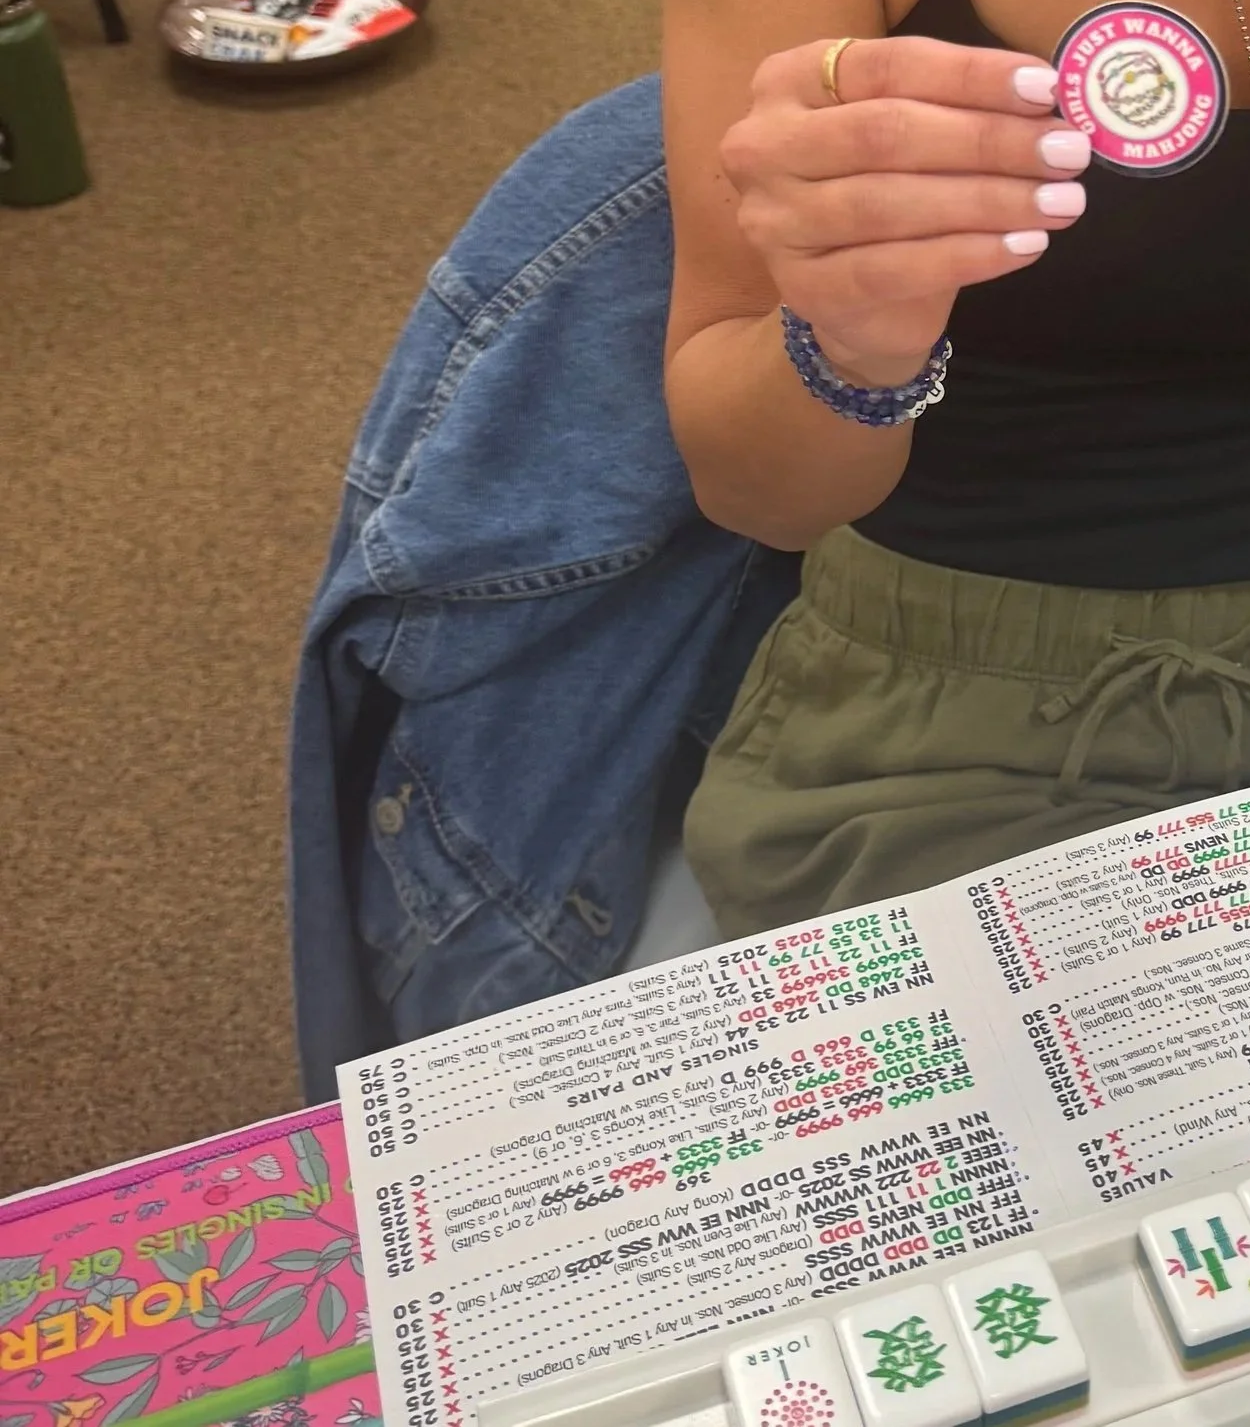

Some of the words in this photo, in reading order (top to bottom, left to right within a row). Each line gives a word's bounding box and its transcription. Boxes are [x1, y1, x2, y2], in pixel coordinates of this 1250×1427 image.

[1072, 23, 1116, 67] JUST
[1122, 18, 1205, 72] WANNA
[1066, 72, 1096, 136] GIRLS
[1122, 94, 1212, 158] MAHJONG
[831, 913, 880, 935] 2025
[887, 906, 908, 921] FF
[774, 928, 825, 951] 2025
[717, 944, 768, 967] 2025
[668, 970, 678, 981] 3
[680, 959, 709, 976] (Any
[628, 974, 666, 992] Suits)
[390, 1057, 405, 1069] C
[681, 1038, 759, 1071] SINGLES
[358, 1064, 383, 1081] 75
[631, 1064, 672, 1086] AND
[567, 1081, 624, 1108] PAIRS
[939, 1075, 975, 1094] 333
[887, 1086, 934, 1109] 6666
[847, 1101, 883, 1121] 666
[957, 1110, 990, 1130] NN
[1214, 1105, 1237, 1121] Any
[795, 1113, 844, 1138] 9999
[926, 1122, 951, 1139] EE
[1173, 1115, 1213, 1136] Wind)
[726, 1138, 764, 1160] 333
[860, 1132, 921, 1160] WWW
[1112, 1145, 1130, 1160] X
[671, 1152, 721, 1177] 6666
[812, 1152, 851, 1174] SSS
[1084, 1154, 1110, 1172] 45
[1119, 1161, 1137, 1176] X
[628, 1170, 666, 1192] 666
[675, 1171, 711, 1192] 369
[740, 1167, 805, 1197] DDDD
[1091, 1170, 1117, 1187] 40
[1100, 1168, 1173, 1202] VALUES
[297, 1182, 332, 1210] IN
[573, 1184, 624, 1210] 9999
[693, 1187, 734, 1209] (Kong
[990, 1189, 1022, 1210] FFF
[537, 1199, 567, 1220] (Any
[664, 1203, 689, 1220] Any
[953, 1200, 986, 1221] NN
[1007, 1205, 1029, 1223] FF
[493, 1225, 504, 1237] 3
[506, 1218, 521, 1232] or
[523, 1214, 535, 1227] 2
[604, 1214, 660, 1241] Dragon)
[924, 1211, 949, 1230] EE
[966, 1213, 1004, 1234] 123
[135, 1203, 286, 1260] SINGLES
[451, 1230, 491, 1251] Suits)
[861, 1221, 921, 1251] WWW
[932, 1225, 964, 1245] DD
[972, 1222, 1034, 1248] NNNN
[420, 1248, 437, 1265] X
[804, 1242, 853, 1268] SSSS
[883, 1236, 929, 1260] DDD
[69, 1247, 124, 1282] OR
[386, 1257, 415, 1277] 25
[819, 1252, 879, 1281] DDDD
[772, 1283, 783, 1295] 3
[784, 1271, 813, 1289] (Any
[428, 1291, 445, 1305] C
[0, 1266, 220, 1371] JOKER
[393, 1299, 421, 1319] 30
[655, 1319, 678, 1335] Any
[680, 1314, 694, 1326] in
[644, 1329, 652, 1341] 1
[575, 1353, 586, 1366] 3
[587, 1343, 611, 1359] Any
[745, 1334, 811, 1367] JOKER
[517, 1357, 574, 1387] Dragons)
